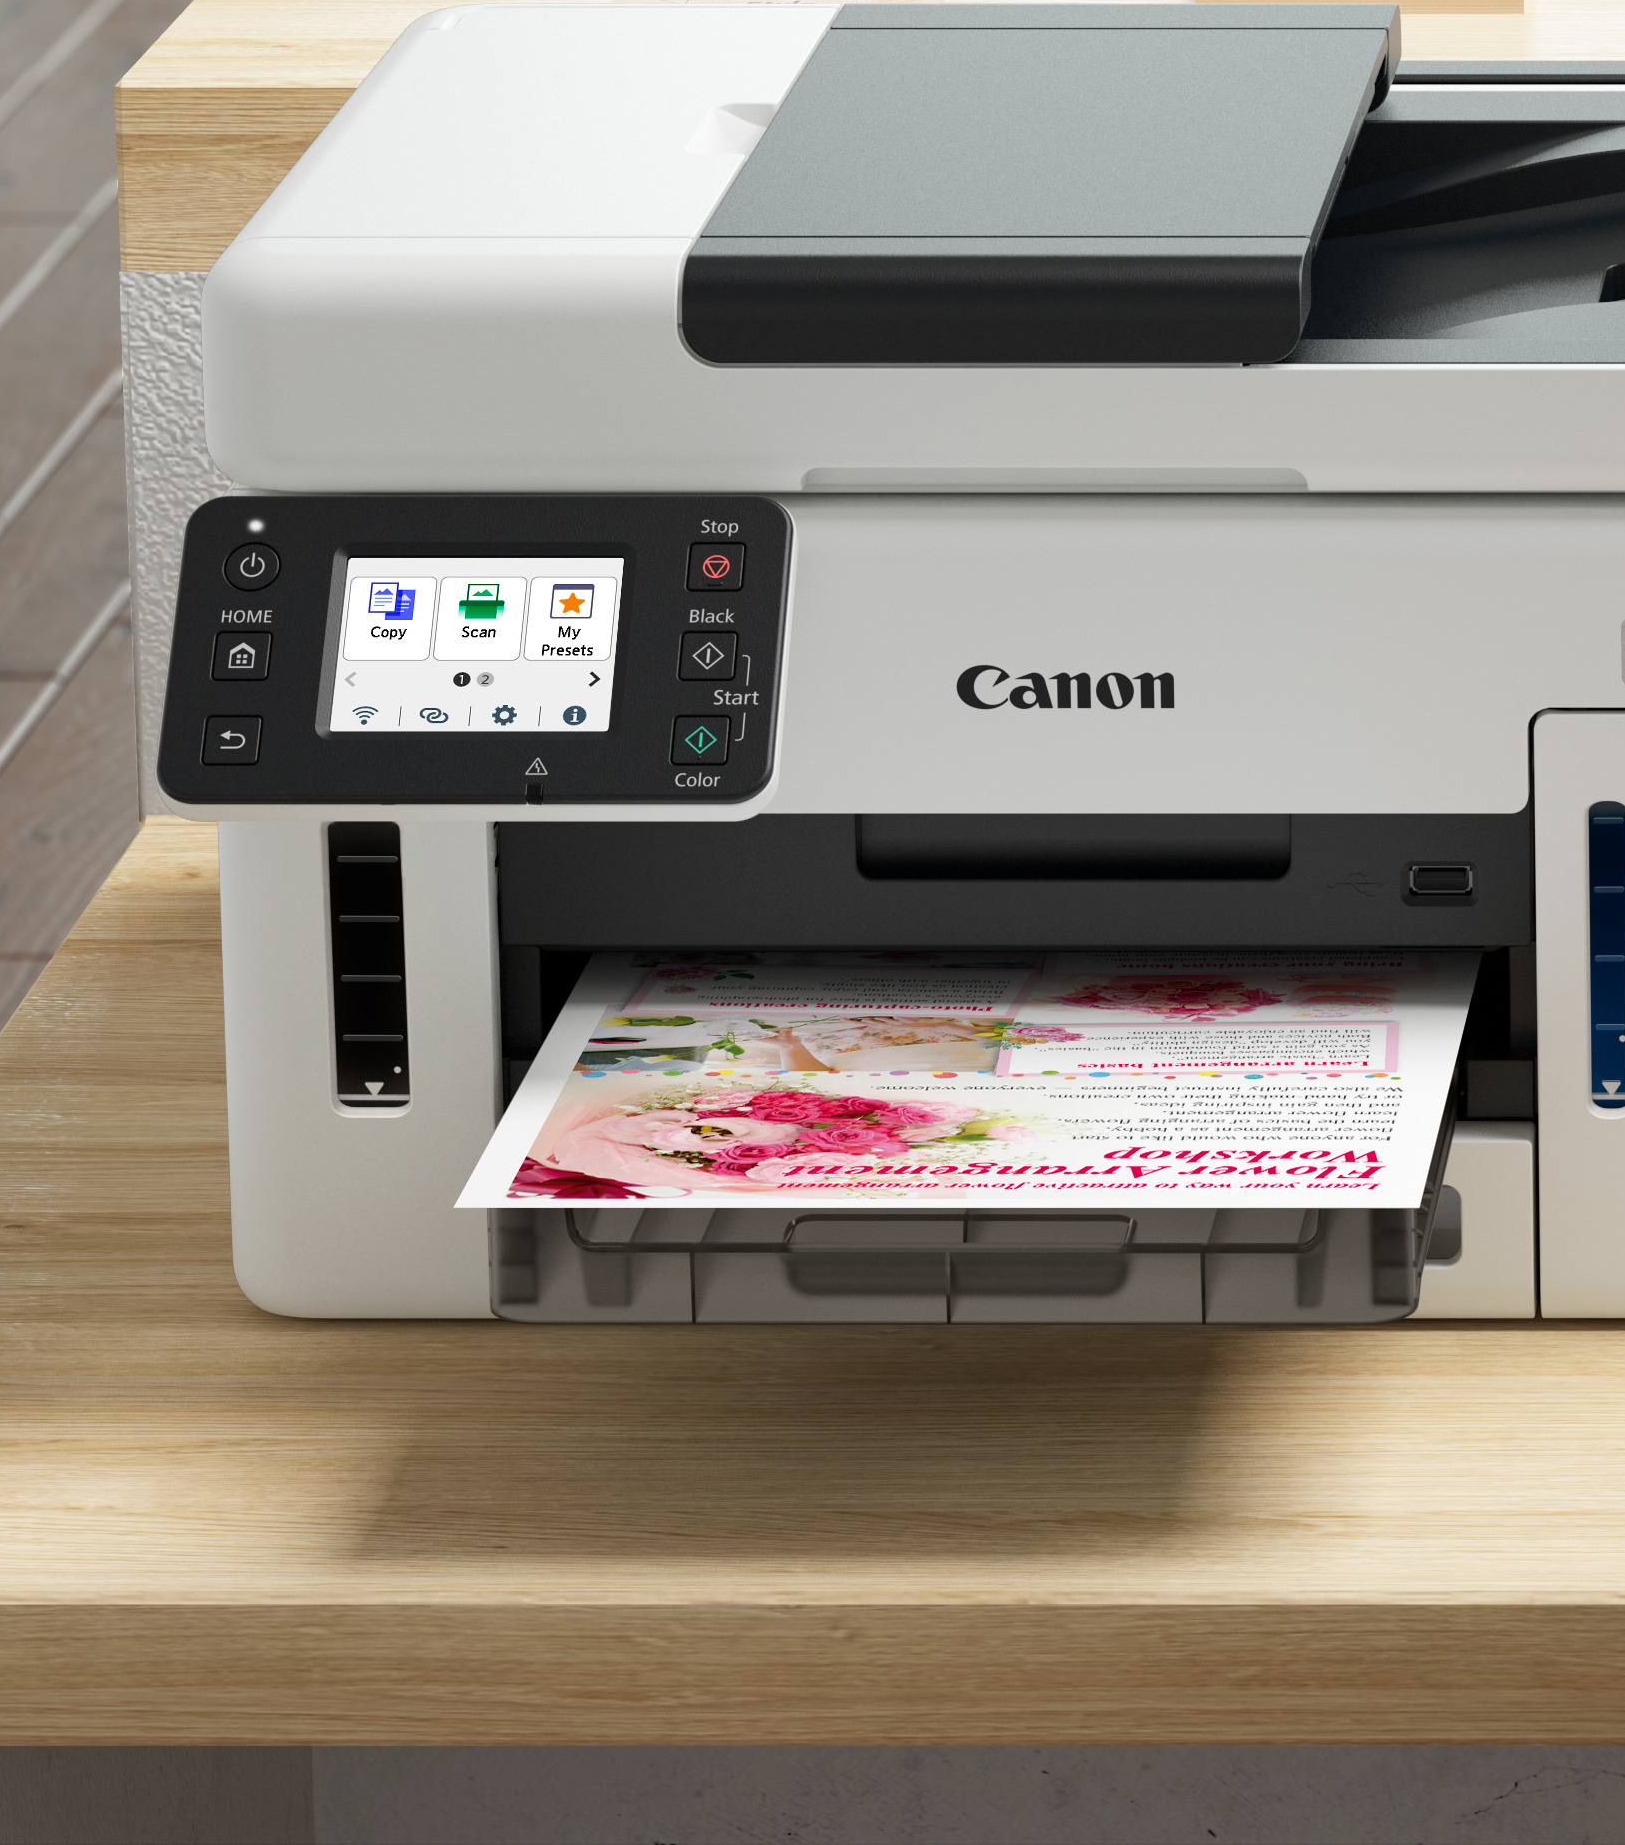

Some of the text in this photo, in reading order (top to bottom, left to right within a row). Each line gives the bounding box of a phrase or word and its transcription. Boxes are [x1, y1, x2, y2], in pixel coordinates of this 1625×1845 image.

[701, 519, 739, 537] Stop
[221, 609, 273, 624] HOME
[689, 608, 735, 624] Black
[370, 625, 408, 641] Copy
[461, 625, 497, 639] Scan
[557, 625, 582, 642] My
[541, 642, 594, 658] Presets
[956, 664, 1175, 710] Canon
[713, 689, 760, 706] Start
[674, 771, 721, 788] Color
[1103, 1146, 1384, 1164] Workshop
[782, 1162, 1387, 1180] Flower Arrangement
